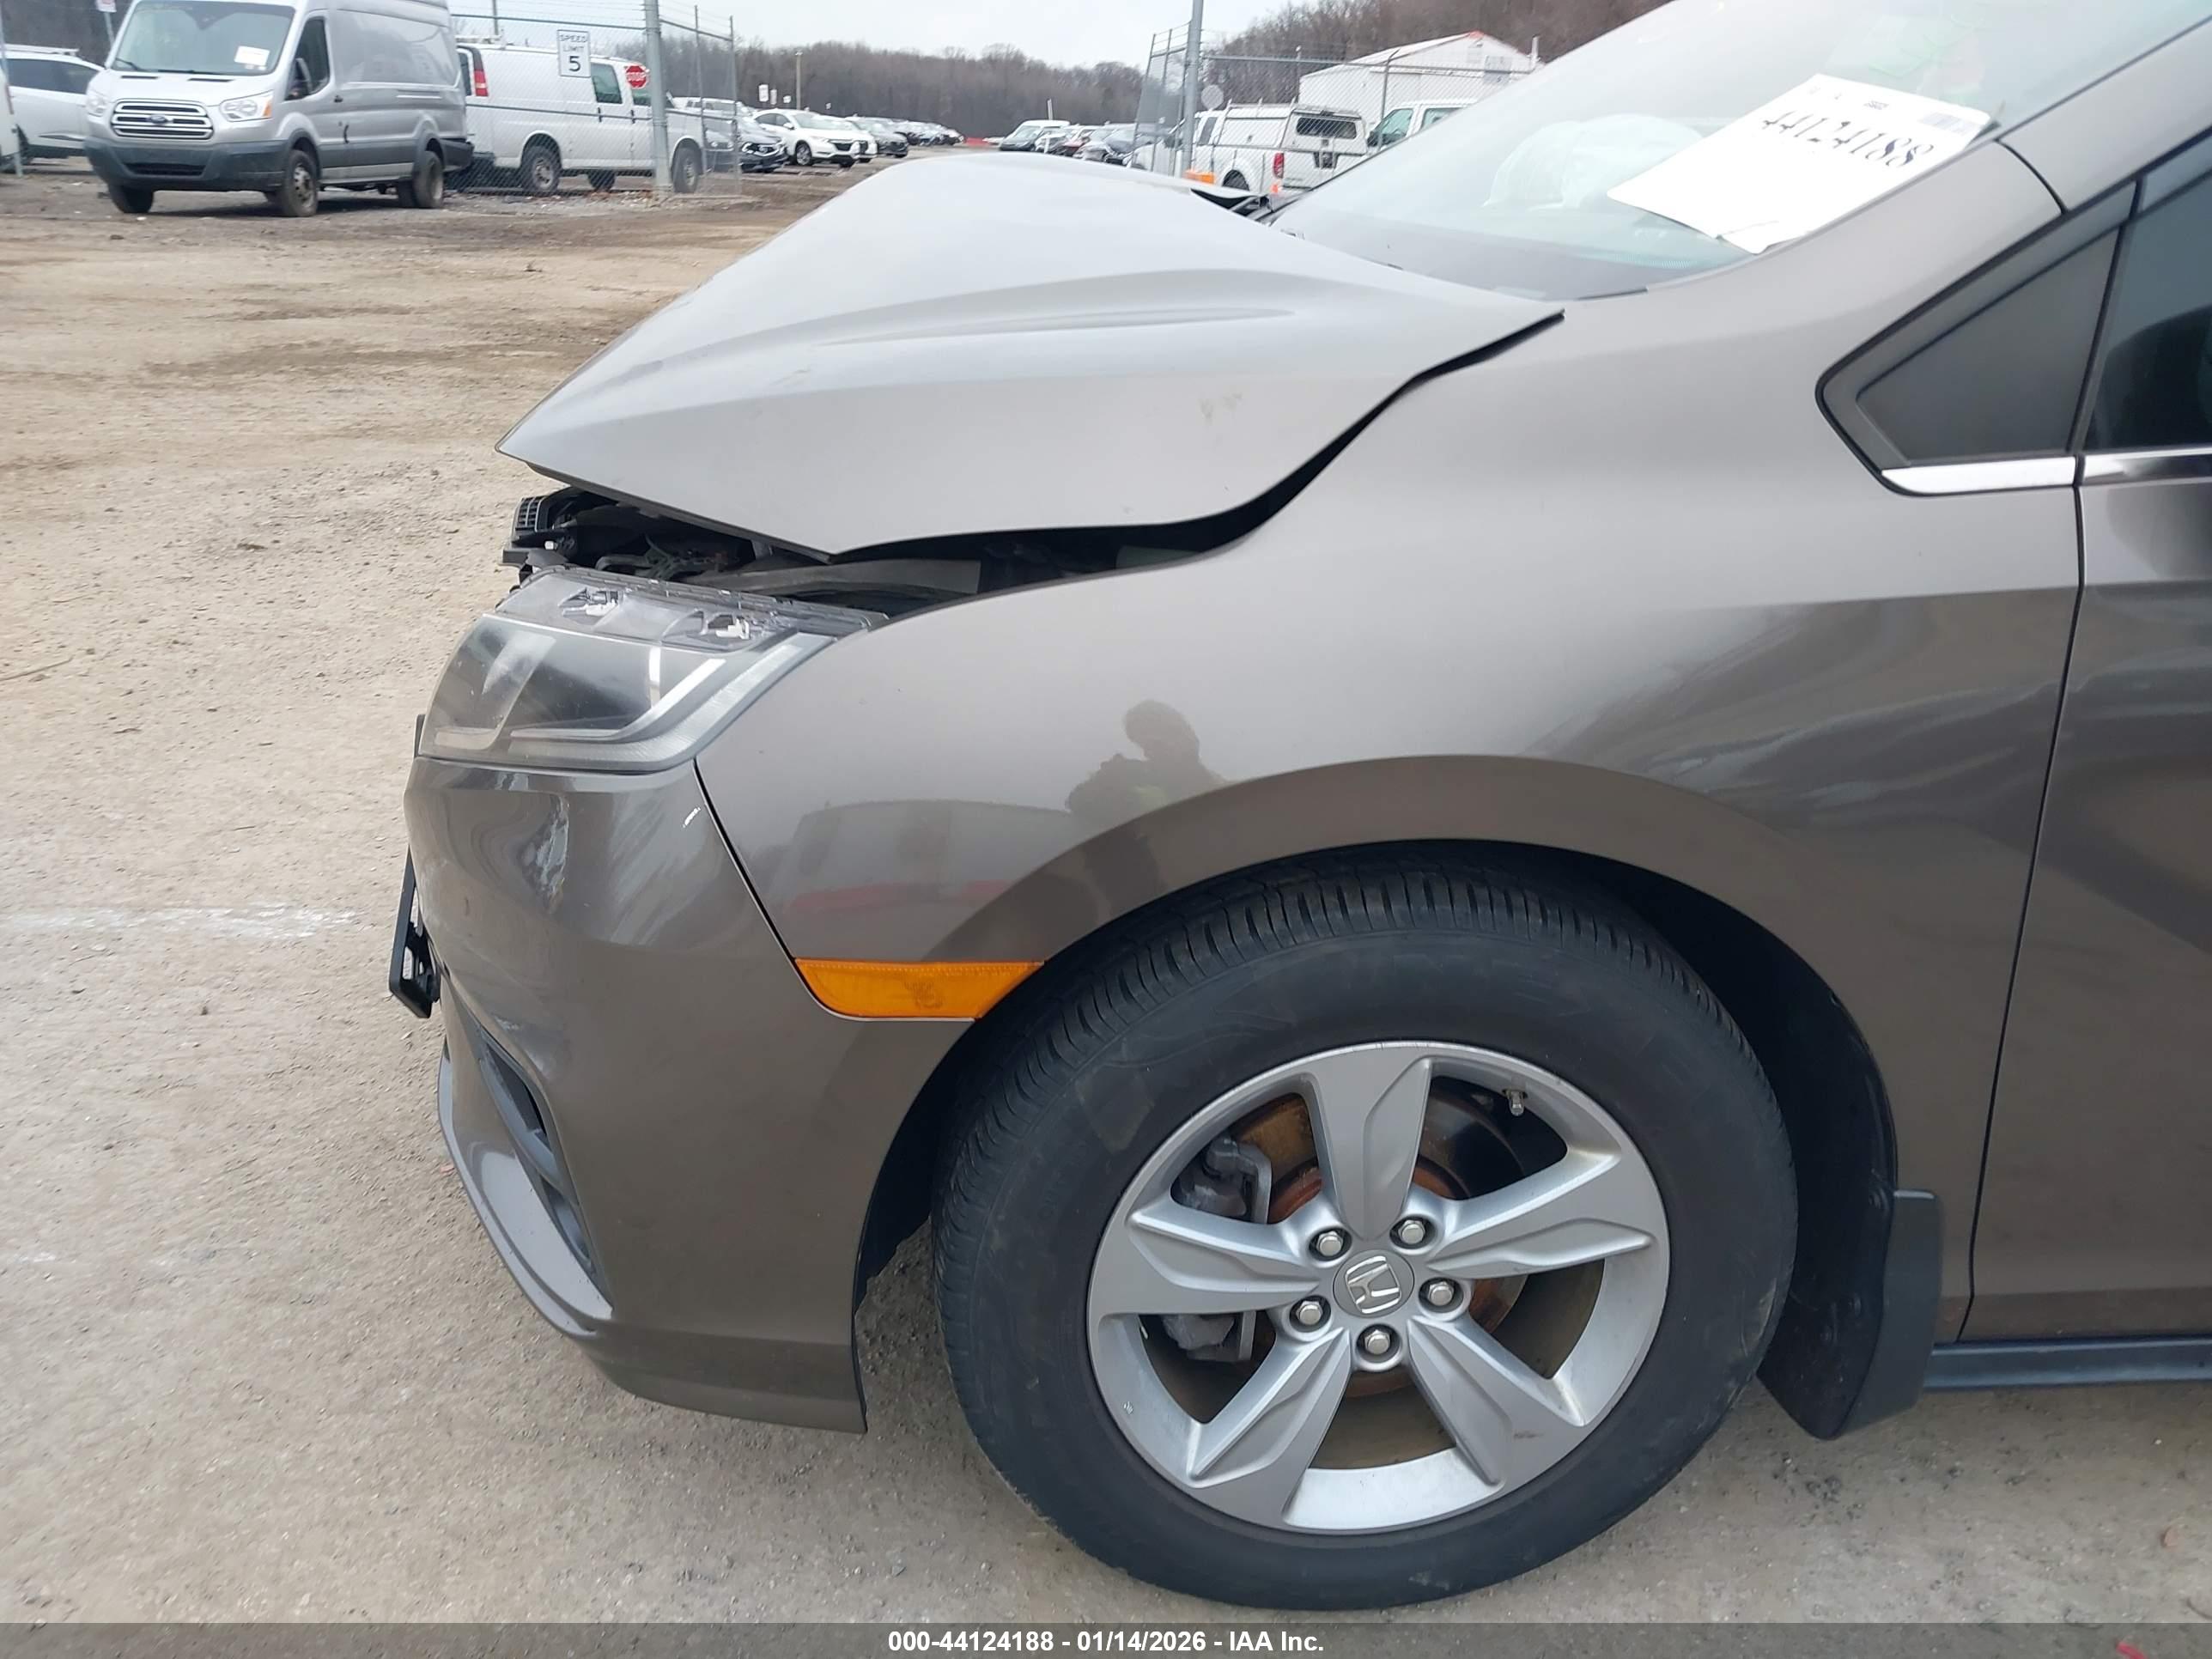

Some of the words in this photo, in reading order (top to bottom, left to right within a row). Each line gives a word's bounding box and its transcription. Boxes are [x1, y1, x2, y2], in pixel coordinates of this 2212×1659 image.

[559, 34, 587, 43] SPEED
[568, 55, 581, 72] 5
[1761, 110, 1935, 167] 44124188
